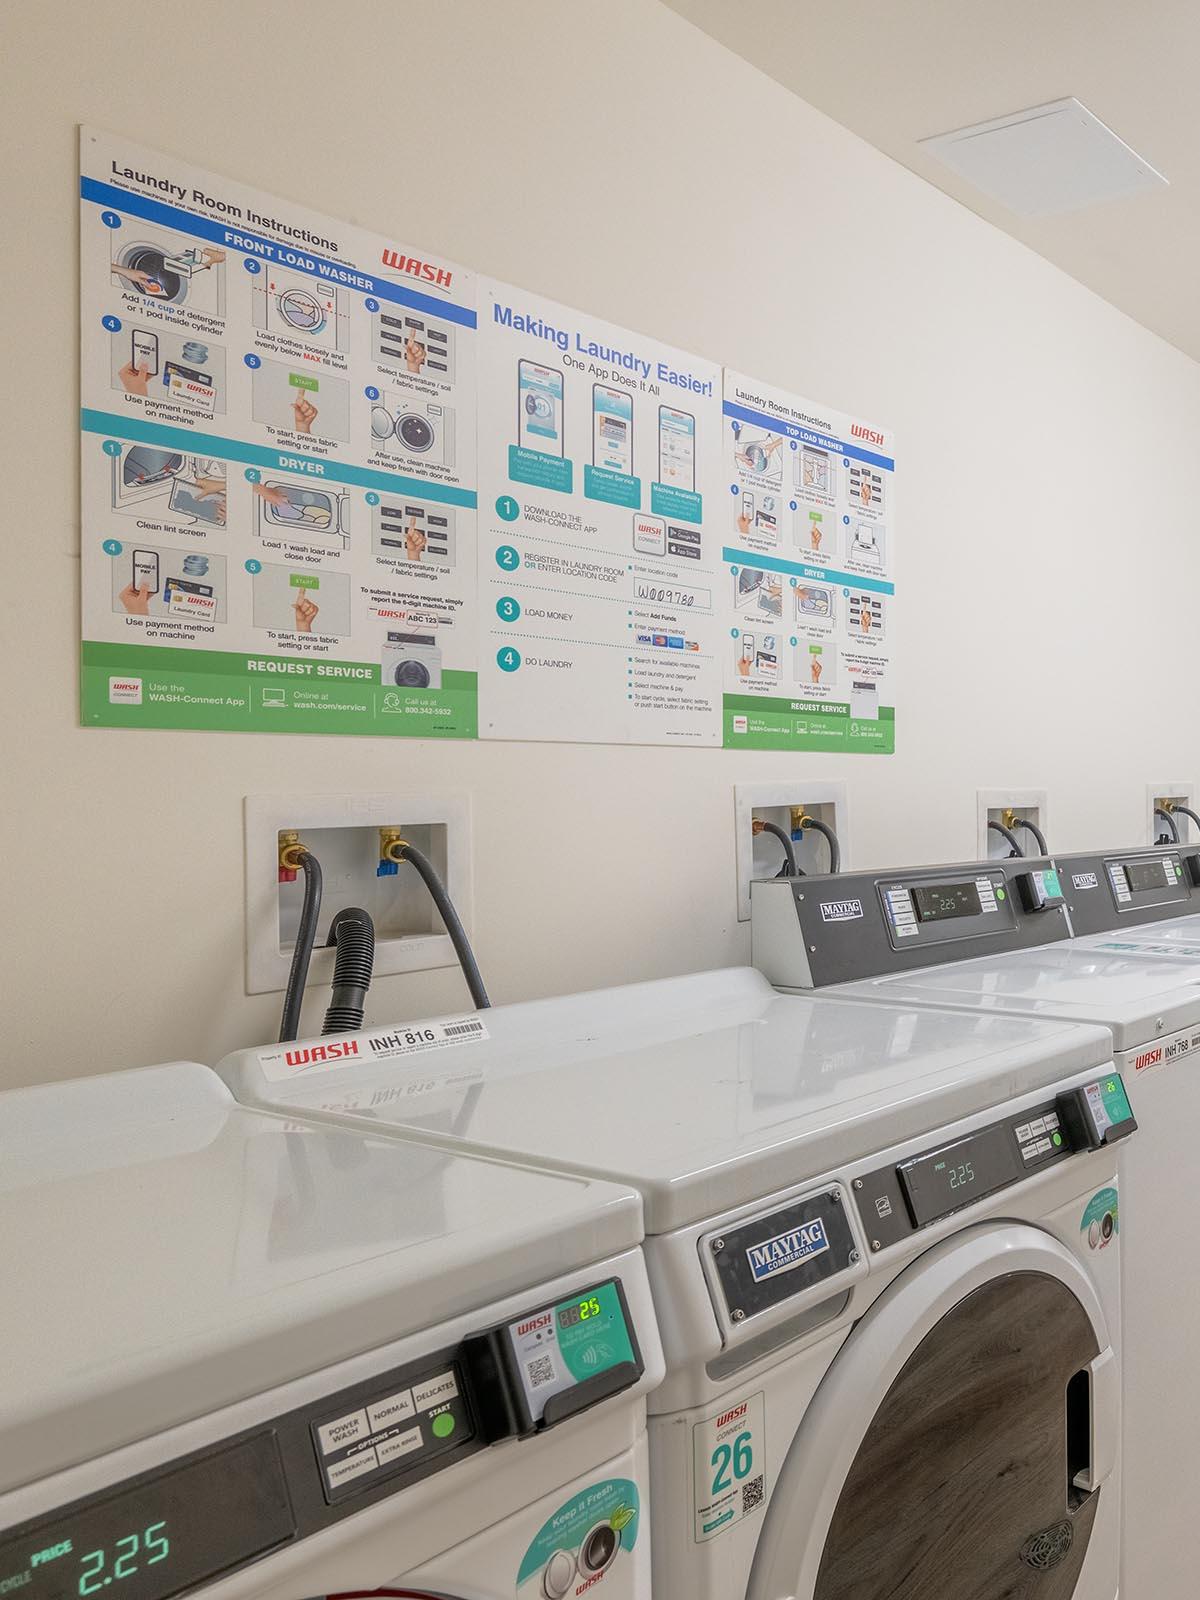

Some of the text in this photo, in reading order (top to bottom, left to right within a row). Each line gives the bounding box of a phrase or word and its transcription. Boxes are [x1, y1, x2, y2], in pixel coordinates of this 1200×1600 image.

[112, 161, 338, 252] Laundry Room Instructions
[225, 232, 374, 291] FRONT LOAD WASHER
[382, 248, 453, 288] WASH
[122, 293, 139, 304] Add
[142, 298, 155, 309] 1/4
[158, 303, 175, 314] cup
[187, 312, 226, 328] detergent
[146, 311, 163, 321] pod
[165, 316, 189, 328] inside
[192, 322, 224, 336] cylinder
[255, 339, 348, 370] evenly below MAX fill level
[256, 331, 344, 361] Load clothes loosely and
[494, 303, 568, 351] Making
[576, 333, 651, 379] Laundry
[658, 364, 712, 397] Easier!
[562, 354, 585, 370] One
[588, 363, 608, 379] App
[612, 372, 637, 389] Does
[648, 385, 660, 396] All
[125, 394, 214, 421] Use payment method
[736, 388, 766, 408] Laundry
[768, 401, 789, 415] Room
[791, 409, 831, 430] Instructions
[159, 413, 194, 426] machine
[266, 425, 338, 448] To start, press fabric
[786, 426, 843, 452] TOP LOAD WASHER
[851, 424, 884, 445] WASH
[276, 438, 301, 450] setting
[312, 445, 328, 454] start
[278, 456, 324, 475] DRYER
[503, 501, 511, 514] 1
[524, 505, 582, 522] DOWNLOAD THE
[136, 521, 206, 537] Clean lint screen
[524, 513, 597, 534] WASH-CONNECT APP
[639, 524, 662, 535] WASH
[503, 551, 512, 564] 2
[525, 553, 560, 565] REGISTER
[569, 562, 603, 573] LAUNDRY
[604, 567, 624, 576] ROOM
[525, 561, 617, 583] OR ENTER LOCATION CODE
[804, 568, 826, 579] DRYER
[377, 609, 437, 624] WASH ABC 123
[504, 602, 513, 615] 3
[525, 608, 573, 621] LOAD MONEY
[505, 652, 513, 665] 4
[525, 658, 573, 669] DO LAUNDRY
[247, 660, 372, 679] REQUEST SERVICE
[149, 683, 167, 691] Use
[294, 691, 319, 700] Online
[149, 694, 245, 706] WASH-Connect App
[294, 702, 366, 712] wash.com/service
[791, 702, 847, 713] REQUEST SERVICE
[823, 902, 860, 915] MAYTAG
[286, 1040, 359, 1066] WASH
[369, 1034, 402, 1051] INH
[406, 1029, 435, 1044] 816
[1136, 1040, 1188, 1070] WASH INH 768
[949, 1162, 975, 1188] 2.25
[751, 1224, 822, 1268] MAYTAG
[768, 1245, 814, 1270] COMMERCIAL
[580, 1297, 600, 1320] 25
[518, 1314, 552, 1335] WASH
[416, 1381, 454, 1402] DELICATES
[373, 1402, 409, 1421] NORMAL
[428, 1403, 451, 1417] START
[717, 1403, 747, 1428] WASH
[328, 1418, 359, 1436] POWER
[332, 1427, 358, 1442] WASH
[716, 1420, 746, 1442] CONNECT
[358, 1432, 389, 1449] OPTIONS
[381, 1444, 400, 1455] EXTRA
[331, 1455, 374, 1479] TEMPERATURE
[712, 1432, 752, 1496] 26
[552, 1511, 576, 1528] Keep
[587, 1484, 613, 1505] Fresh
[31, 1539, 73, 1567] PRICE
[79, 1521, 169, 1596] 2.25
[576, 1570, 604, 1596] WASH
